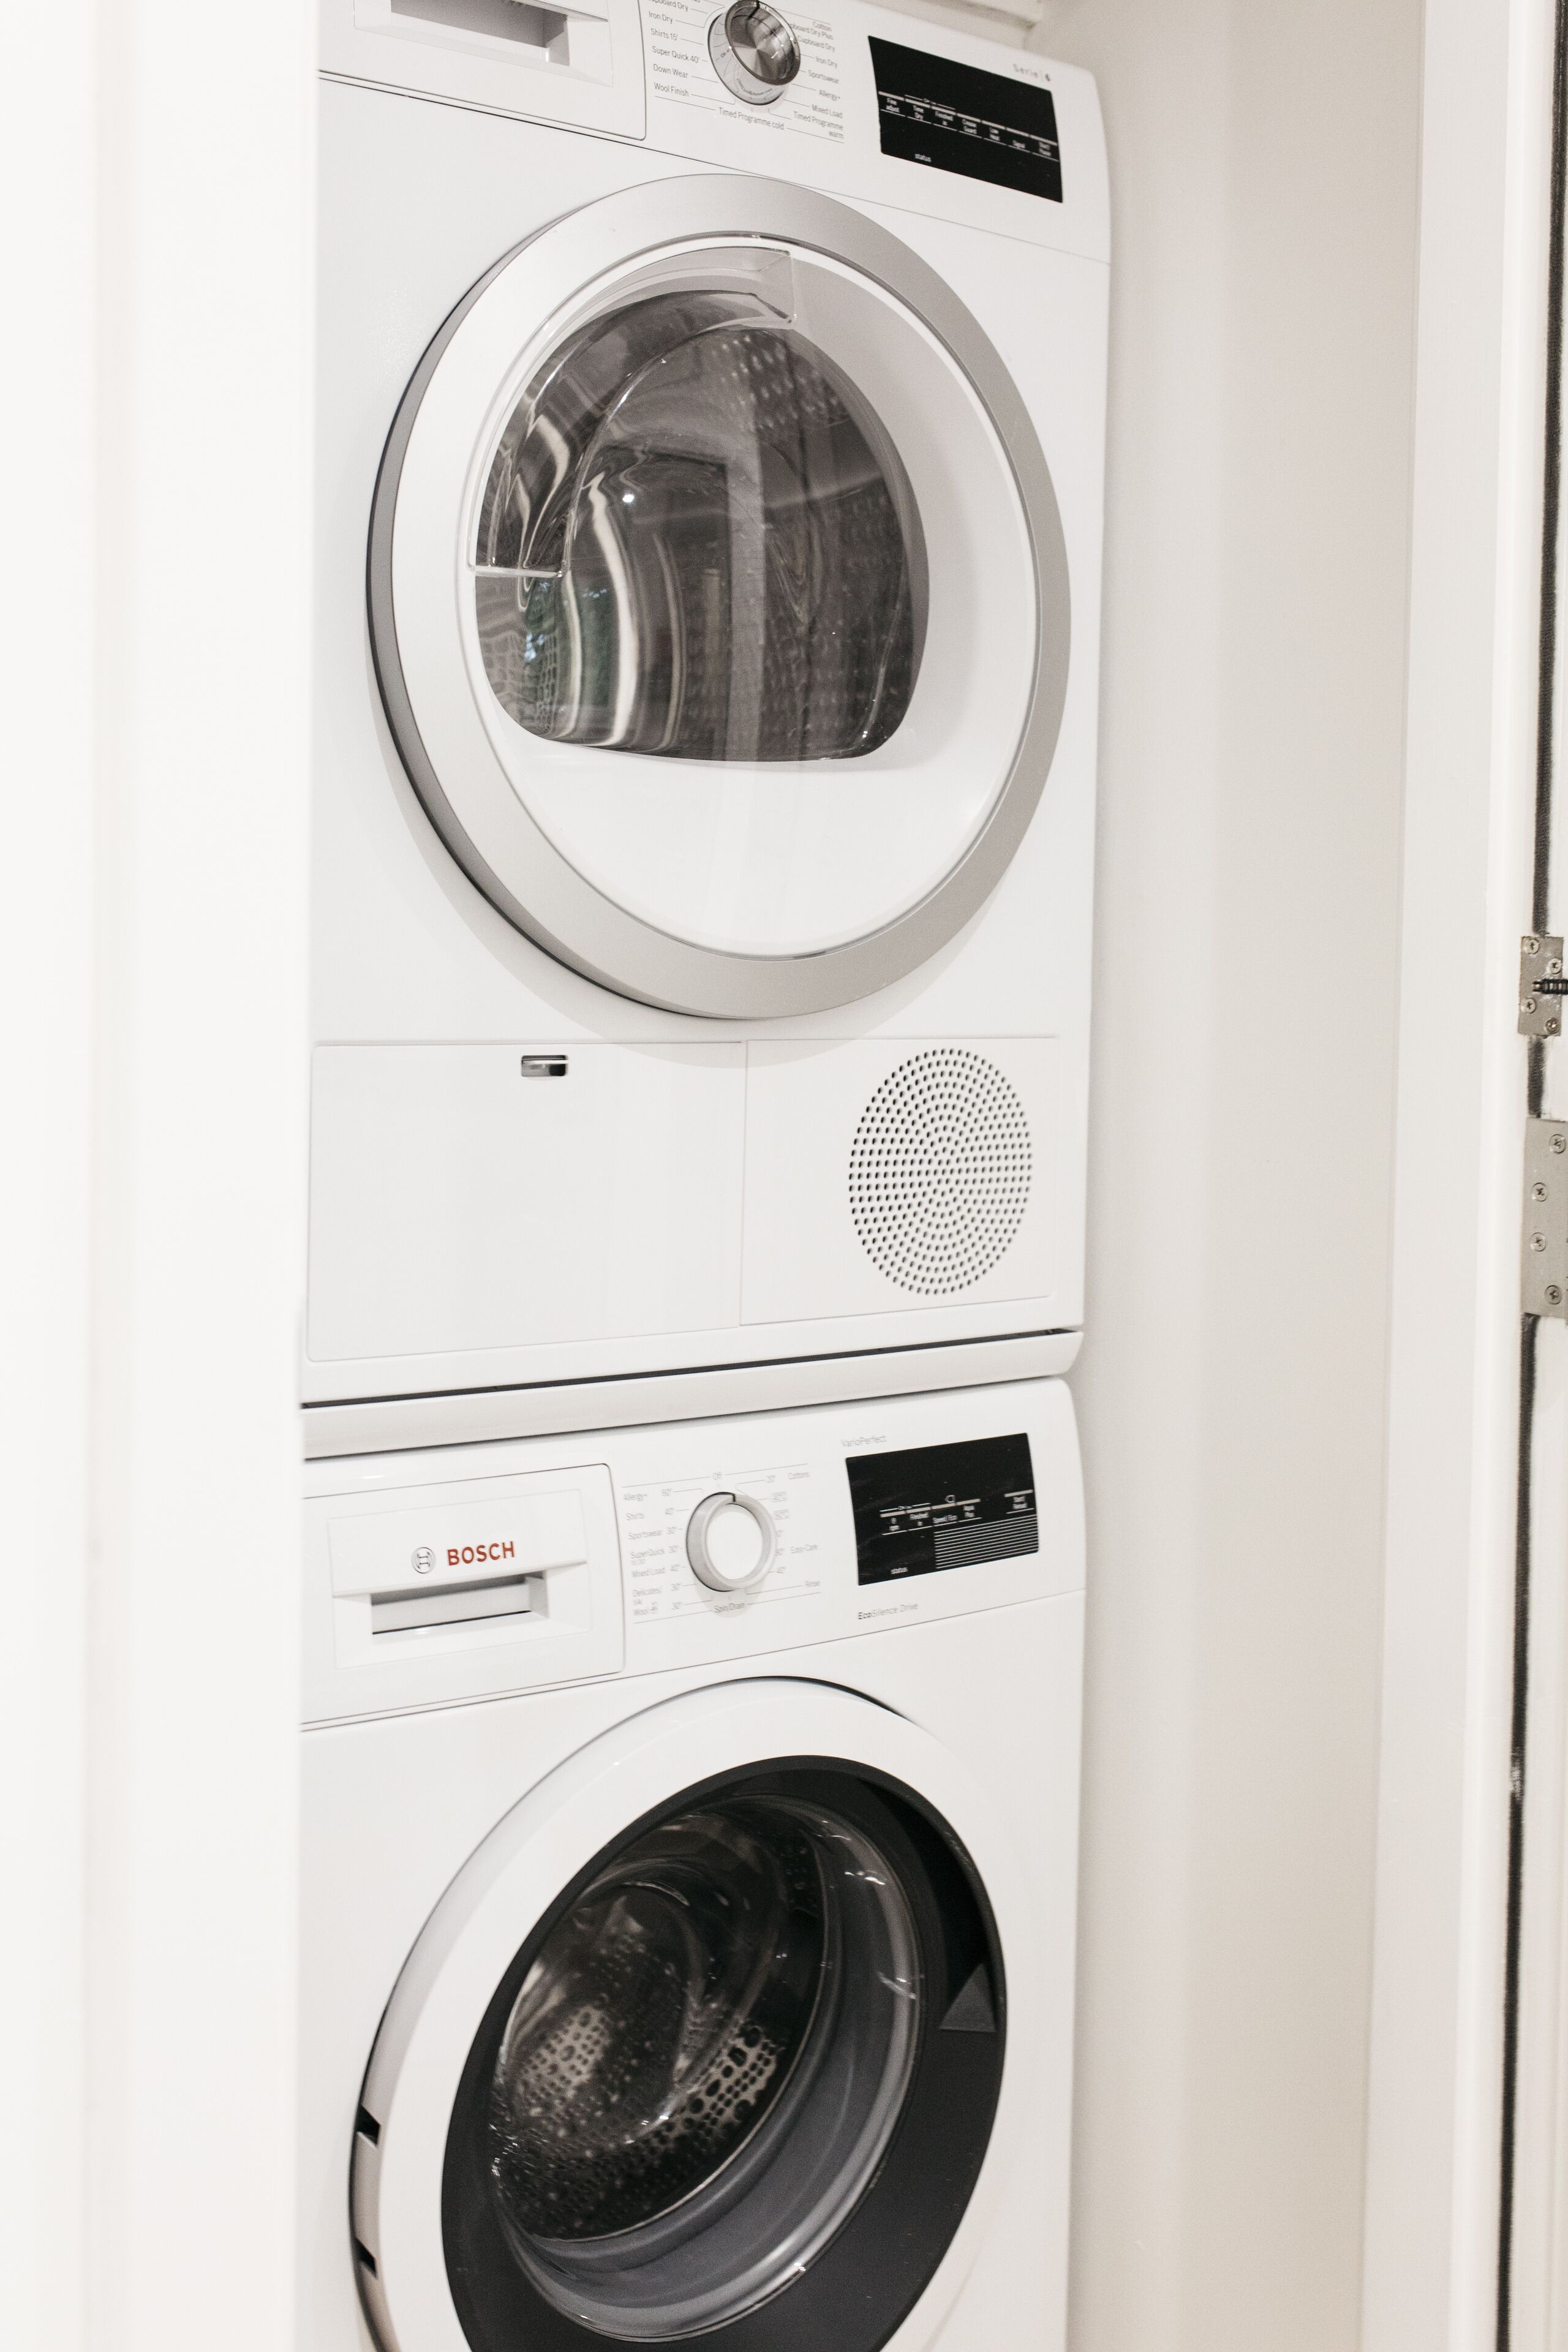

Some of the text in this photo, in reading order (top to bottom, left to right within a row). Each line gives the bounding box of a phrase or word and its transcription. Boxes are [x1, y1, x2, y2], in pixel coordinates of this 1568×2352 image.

[677, 2, 688, 12] Dry
[649, 11, 673, 24] Iron Dry
[650, 28, 669, 39] Shirts
[652, 46, 670, 56] Super
[672, 50, 689, 60] Quick
[825, 43, 835, 53] Dry
[653, 64, 688, 78] Down Wear
[827, 59, 837, 69] Dry
[808, 69, 840, 84] Sportswear
[654, 83, 689, 97] Wool Finish
[812, 104, 843, 118] Mixed Load
[719, 107, 785, 130] Timed Programme cold
[794, 111, 843, 130] Timed Programme
[914, 153, 931, 162] status
[840, 1434, 888, 1447] VarioPerfect
[628, 1530, 662, 1540] Sportswear
[447, 1541, 514, 1566] BOSCH
[858, 1604, 918, 1619] EcoSilence Drive
